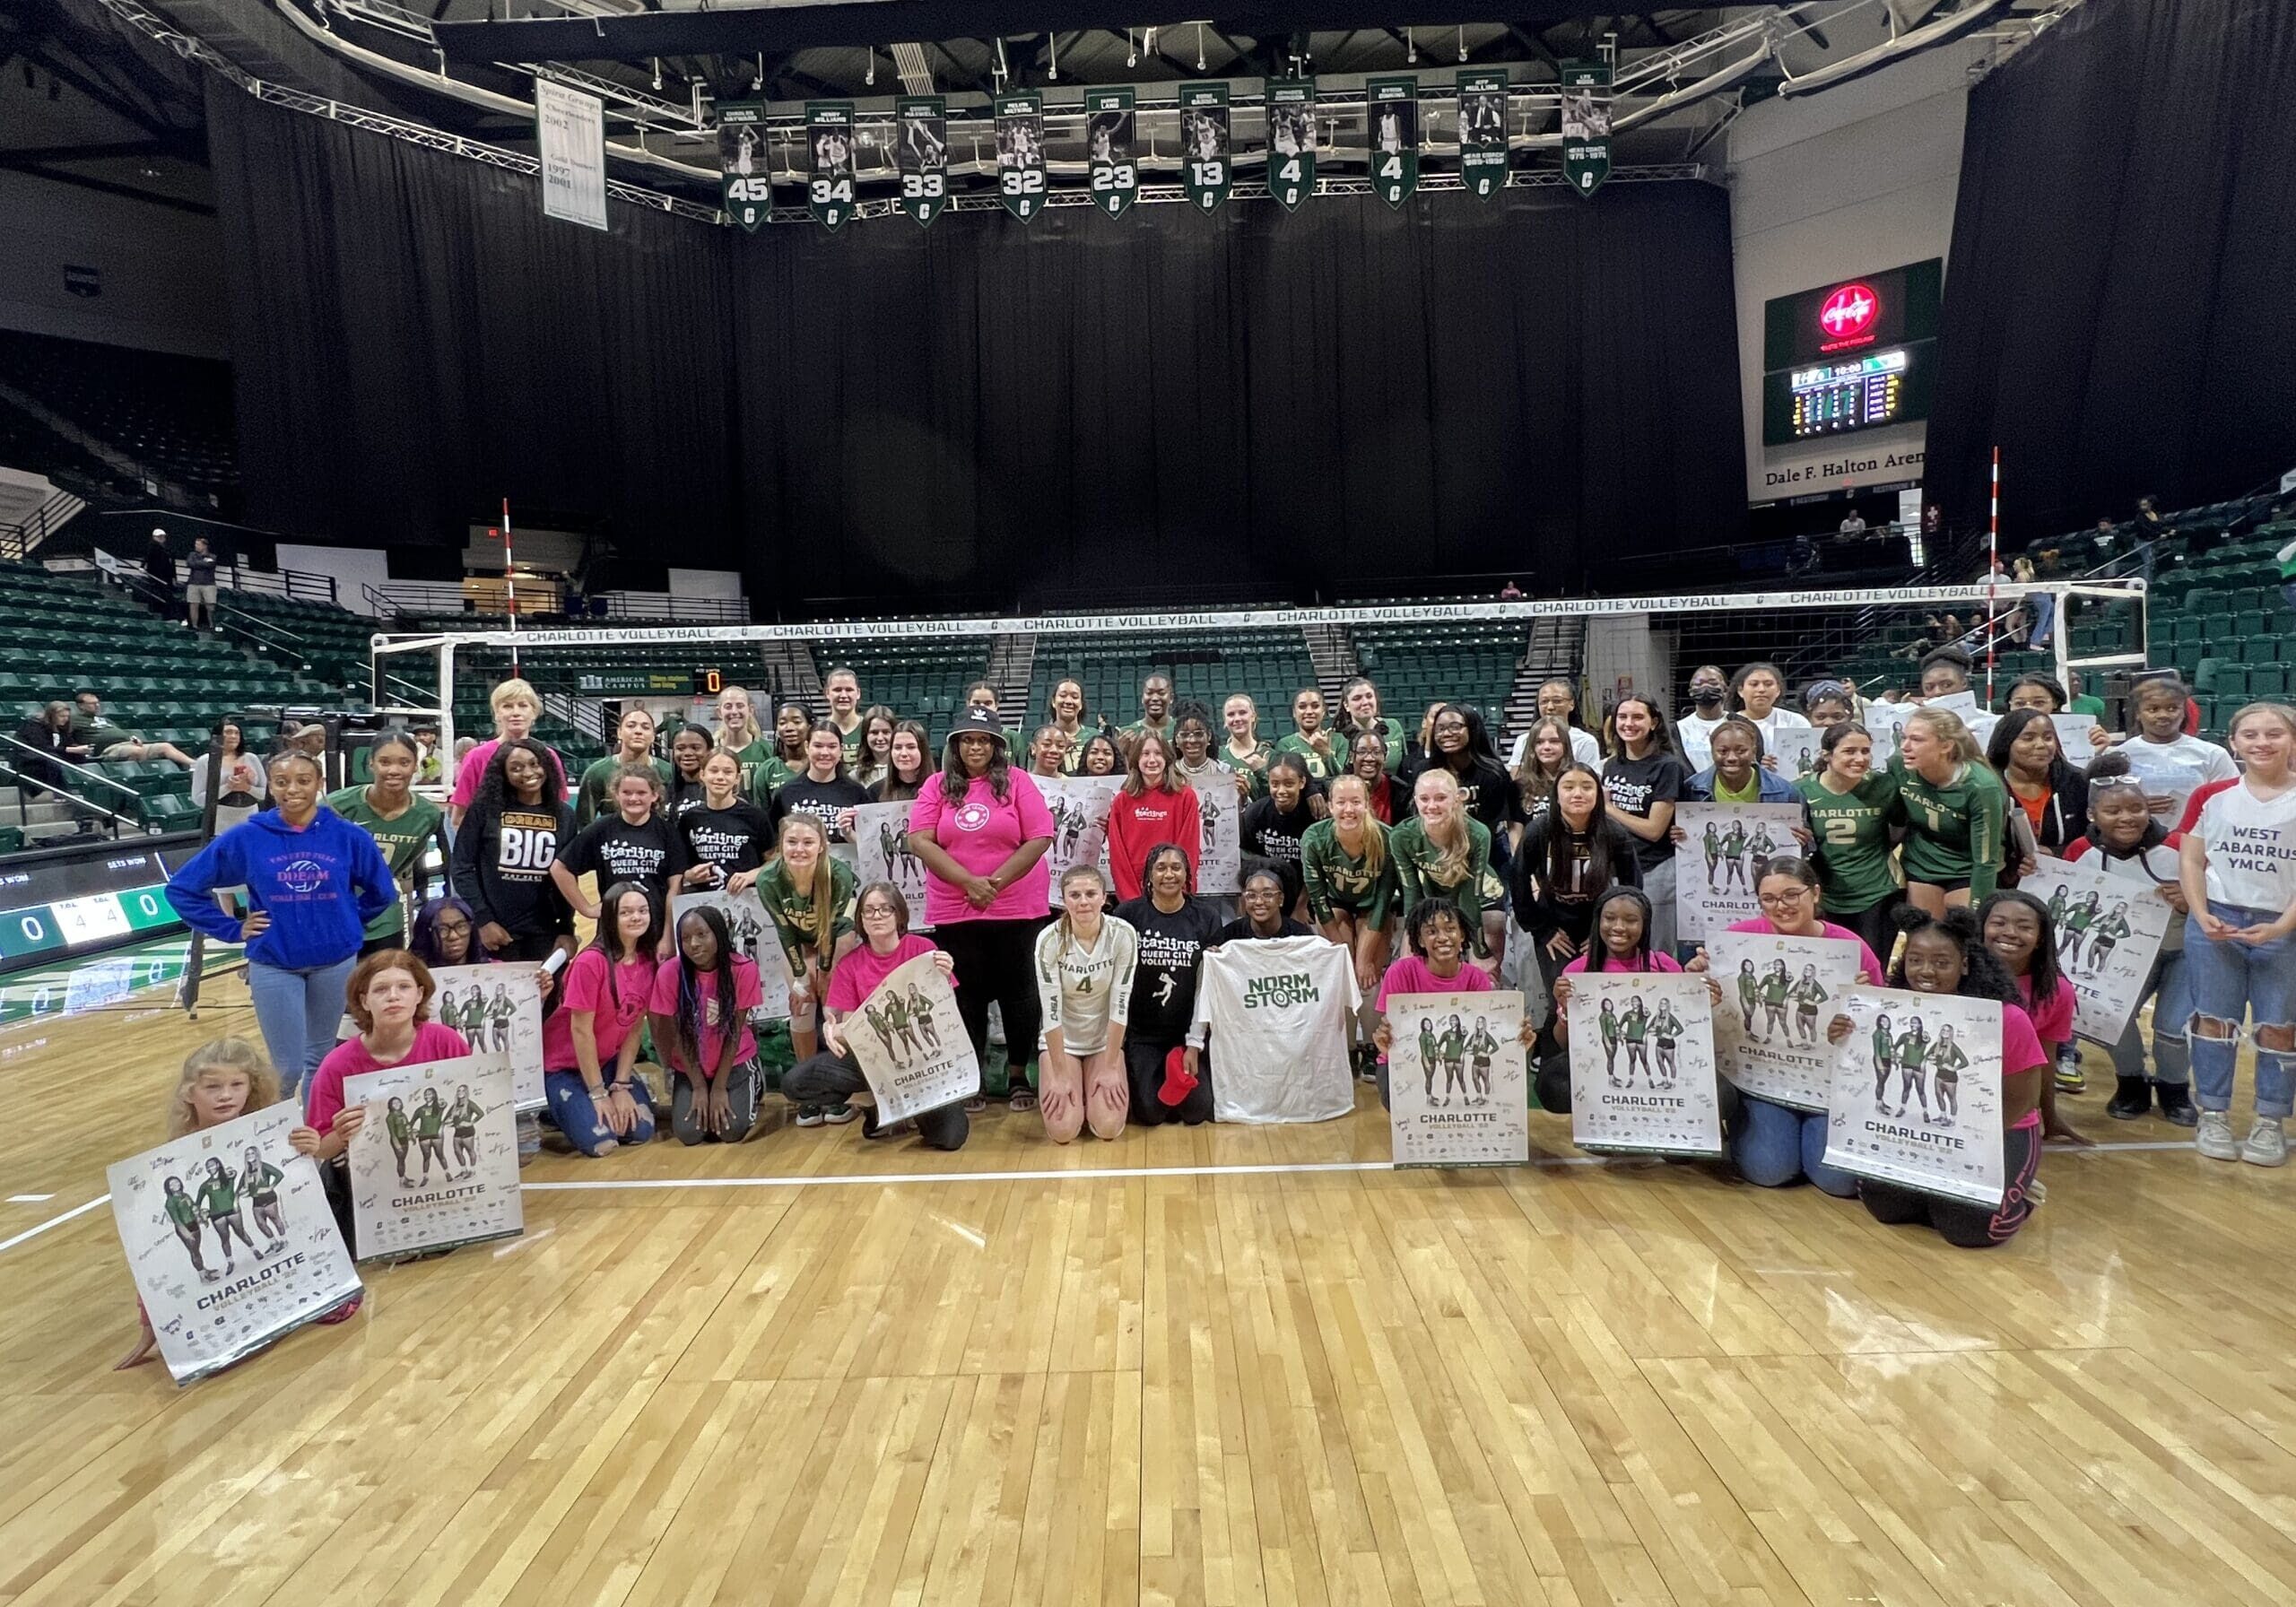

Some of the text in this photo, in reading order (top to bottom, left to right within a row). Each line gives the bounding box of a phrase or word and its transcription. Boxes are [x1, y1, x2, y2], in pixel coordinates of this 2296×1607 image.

[544, 114, 570, 130] 2002
[547, 162, 570, 178] 1997
[1191, 161, 1223, 187] 13
[1279, 159, 1301, 183] 4
[1380, 156, 1403, 179] 4
[548, 174, 571, 189] 2001
[902, 174, 943, 198] 33
[1003, 170, 1044, 195] 32
[1093, 165, 1135, 191] 23
[728, 177, 768, 202] 45
[812, 179, 852, 204] 34
[1766, 451, 1926, 486] Dale F. Halton Aren
[1532, 600, 1624, 613] CHARLOTTE
[1631, 595, 1730, 610] VOLLEYBALL
[1790, 586, 1989, 604] CHARLOTTE VOLLEYBALL
[1024, 617, 1114, 630] CHARLOTTE
[1118, 614, 1217, 628] VOLLEYBALL
[1276, 610, 1368, 623] CHARLOTTE
[1372, 605, 1474, 619] VOLLEYBALL
[526, 630, 615, 643] CHARLOTTE
[618, 628, 716, 641] VOLLEYBALL
[773, 623, 863, 637] CHARLOTTE
[865, 621, 965, 634] VOLLEYBALL
[708, 673, 720, 691] 0
[1810, 807, 1882, 818] HARLOTTE
[373, 833, 419, 844] RLOTTE
[1824, 818, 1857, 845] 2
[2232, 826, 2282, 841] WEST
[500, 827, 556, 869] BIG
[721, 845, 741, 853] CITY
[610, 859, 660, 868] QUEEN CITY
[612, 866, 658, 875] VOLLEYBALL
[2228, 857, 2277, 873] YMCA
[277, 870, 330, 882] DREAM
[1333, 873, 1370, 894] 17
[139, 894, 159, 916] 0
[1701, 900, 1763, 910] CHARLOT
[75, 914, 87, 928] 4
[107, 908, 117, 922] 4
[22, 916, 44, 941] 0
[1141, 950, 1193, 960] QUEEN CITY
[1141, 958, 1192, 968] VOLLEYBALL
[1075, 976, 1093, 994] 4
[1248, 973, 1311, 993] NORM
[1244, 987, 1319, 1009] STORM
[1738, 1046, 1824, 1068] CHARLOTTE
[894, 1059, 954, 1087] CHARLOTTE
[1602, 1094, 1685, 1108] CHARLOTTE
[1420, 1113, 1498, 1124] CHARLOTTE
[1865, 1120, 1965, 1150] CHARLOTTE
[392, 1183, 486, 1209] CHARLOTTE
[196, 1251, 306, 1311] CHARLOTTE
